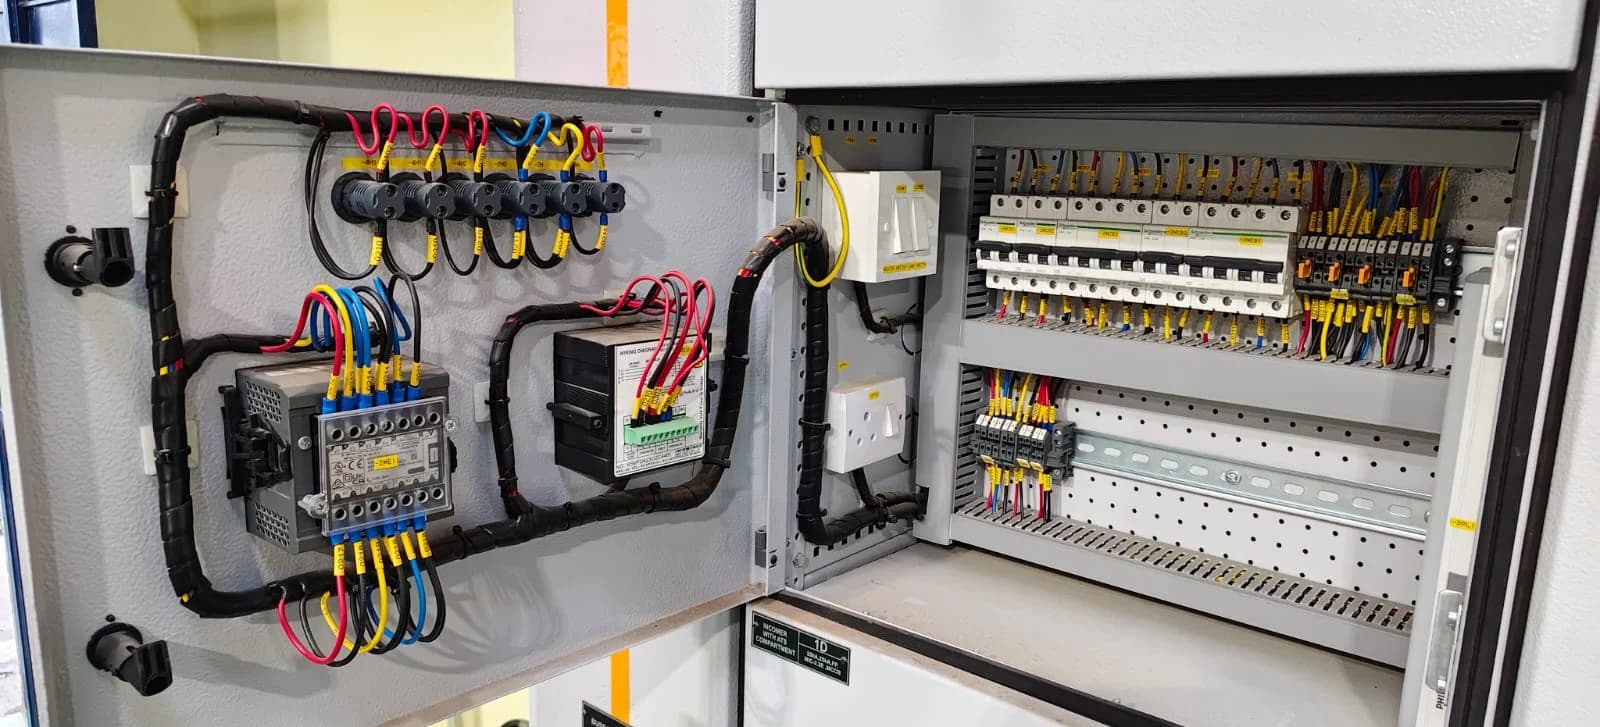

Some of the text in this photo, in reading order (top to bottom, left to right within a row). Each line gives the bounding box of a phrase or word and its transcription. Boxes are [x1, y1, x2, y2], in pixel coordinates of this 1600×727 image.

[762, 622, 788, 637] INCOMER
[762, 630, 776, 641] WITH
[755, 635, 796, 656] COMPARTMENT
[814, 639, 828, 653] 1D
